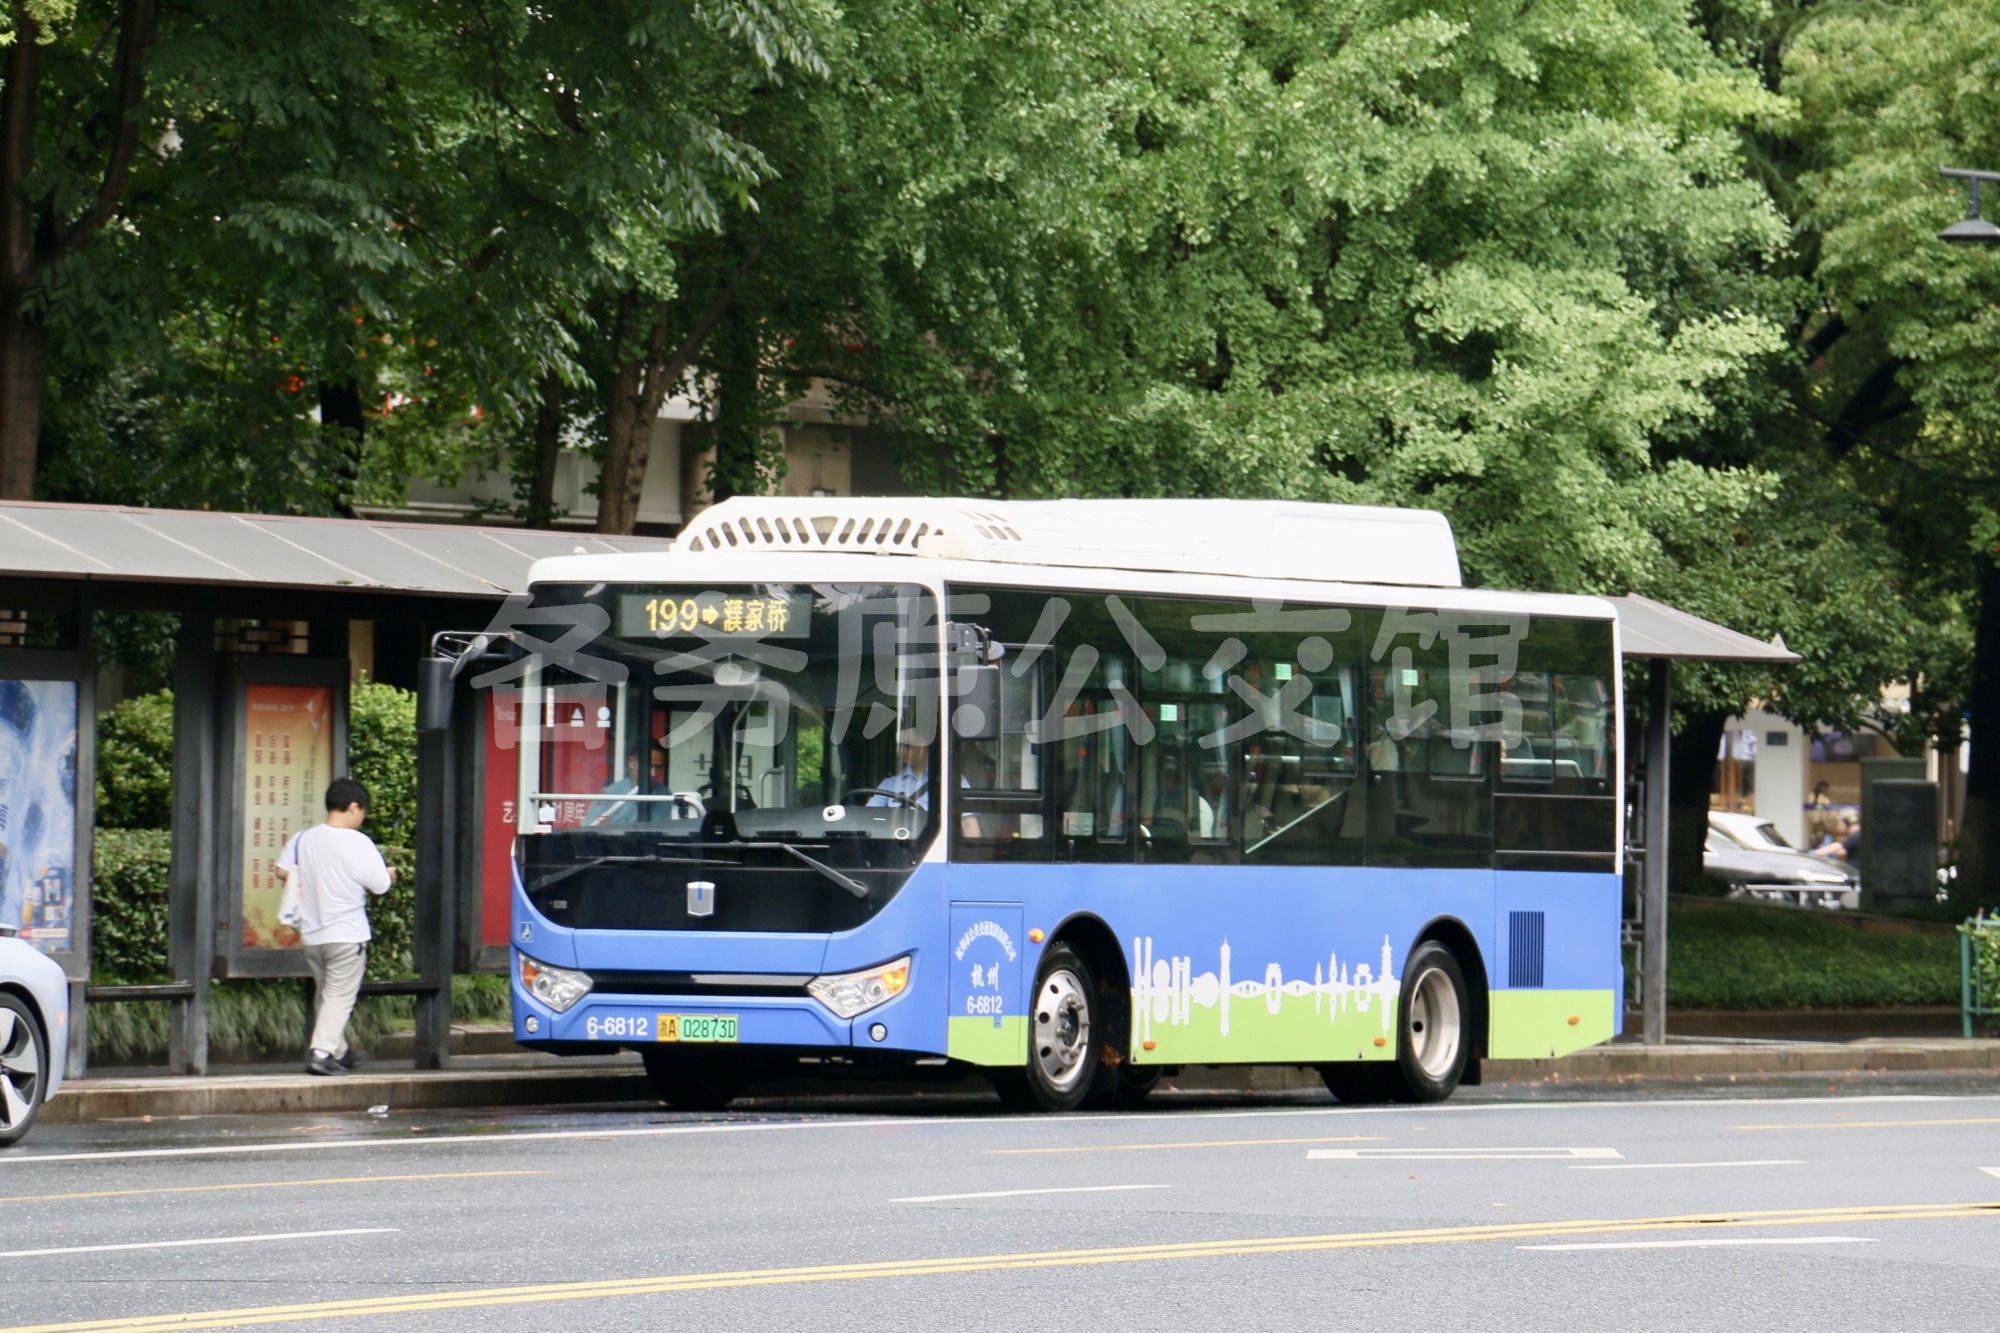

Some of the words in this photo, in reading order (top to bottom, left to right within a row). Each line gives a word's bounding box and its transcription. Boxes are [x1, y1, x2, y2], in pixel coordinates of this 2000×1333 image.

[646, 598, 699, 632] 199
[970, 962, 1000, 991] 杭州
[967, 995, 1003, 1014] 6-6812
[587, 1017, 648, 1037] 6-6812
[683, 1019, 737, 1038] 02873D
